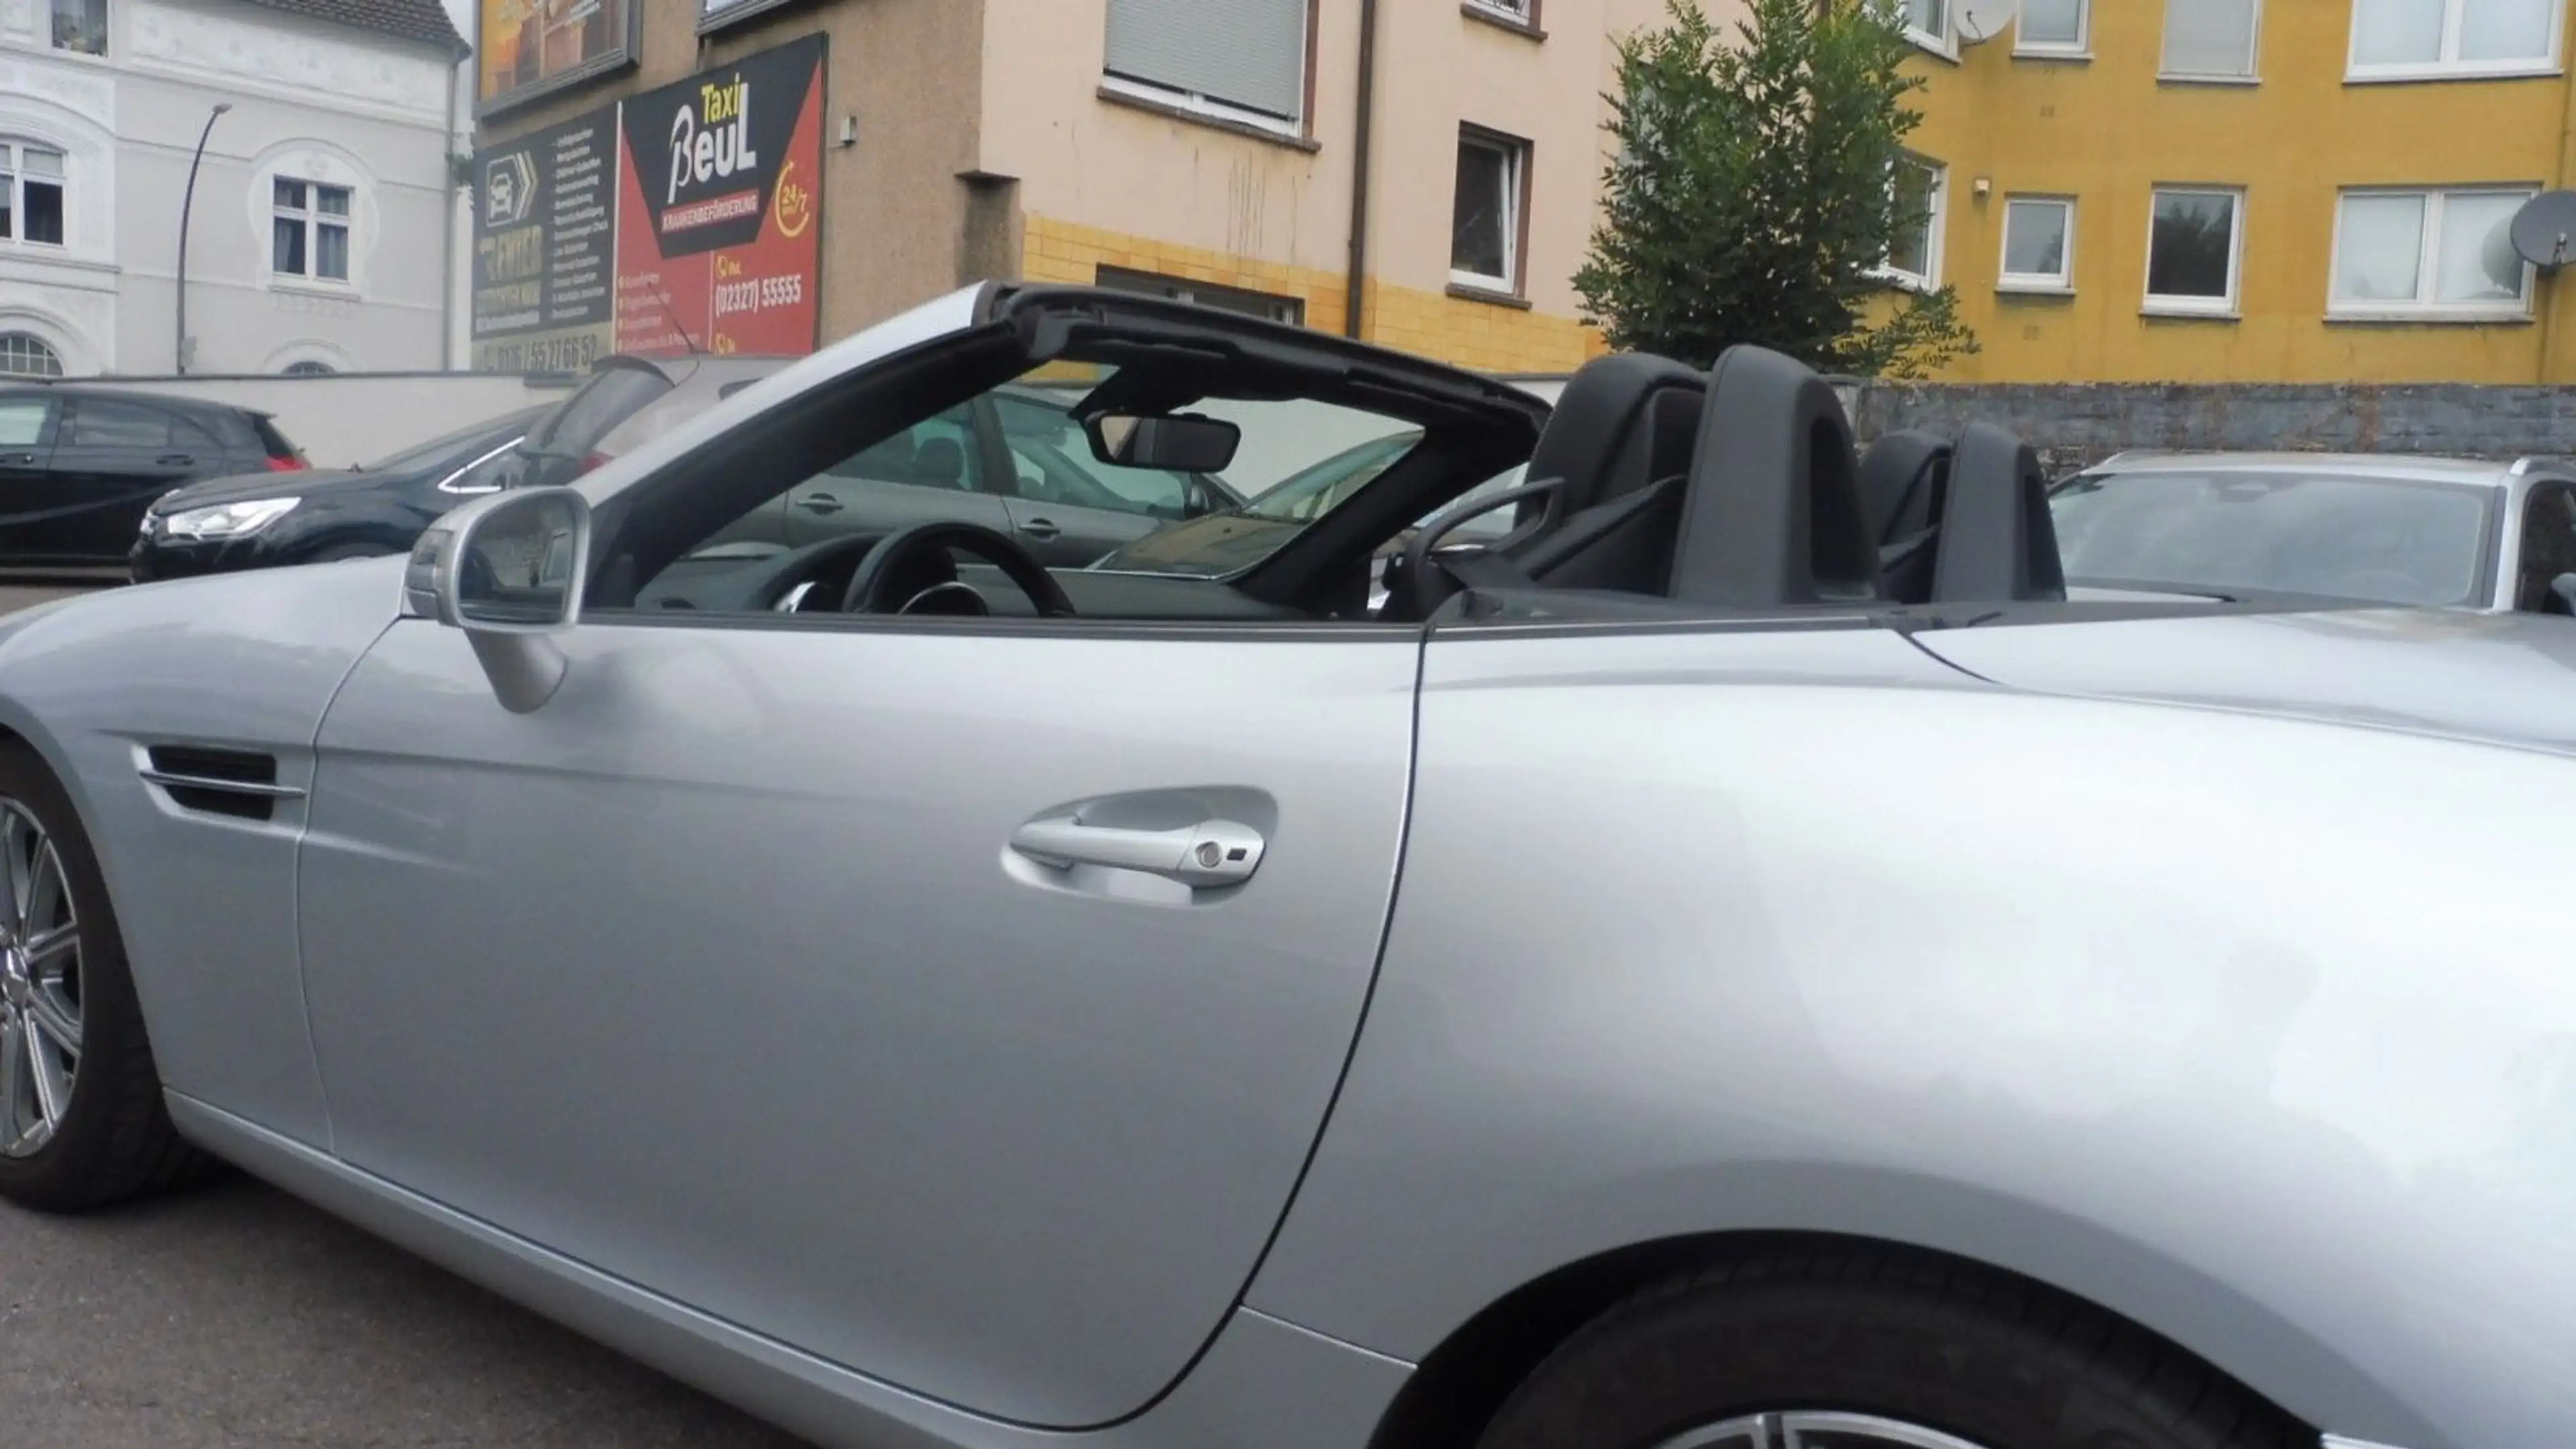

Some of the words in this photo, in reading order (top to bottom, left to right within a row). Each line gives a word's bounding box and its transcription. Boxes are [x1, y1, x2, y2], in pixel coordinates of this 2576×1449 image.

[702, 72, 741, 124] Taxi
[716, 278, 759, 318] (02327)
[762, 274, 802, 307] 55555
